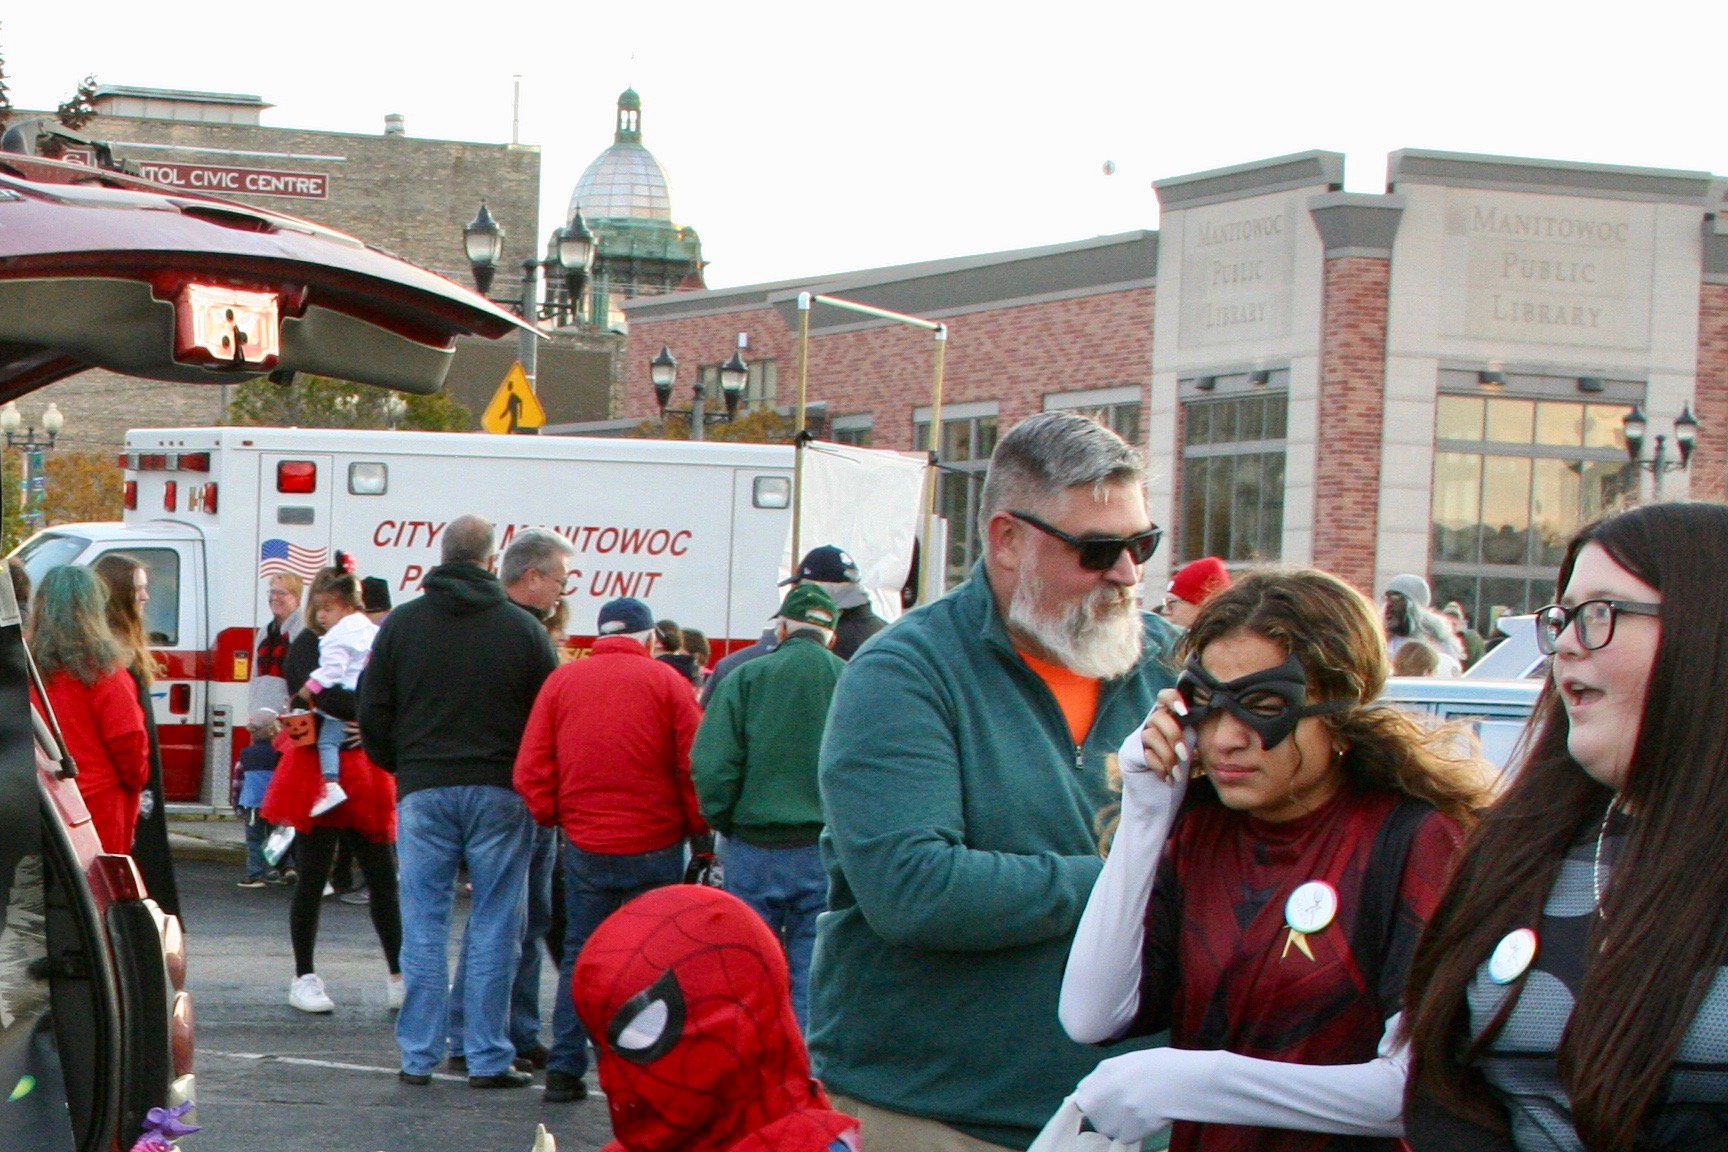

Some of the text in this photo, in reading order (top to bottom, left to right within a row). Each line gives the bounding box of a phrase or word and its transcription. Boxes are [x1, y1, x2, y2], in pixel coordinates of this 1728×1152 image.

[189, 170, 239, 189] CIVIC
[245, 174, 323, 195] CENTRE
[1471, 206, 1629, 243] MANITOWOC
[1502, 252, 1597, 283] PUBLIC
[1491, 294, 1601, 328] LIBRARY
[372, 520, 446, 548] CITY
[588, 570, 663, 598] UNIT
